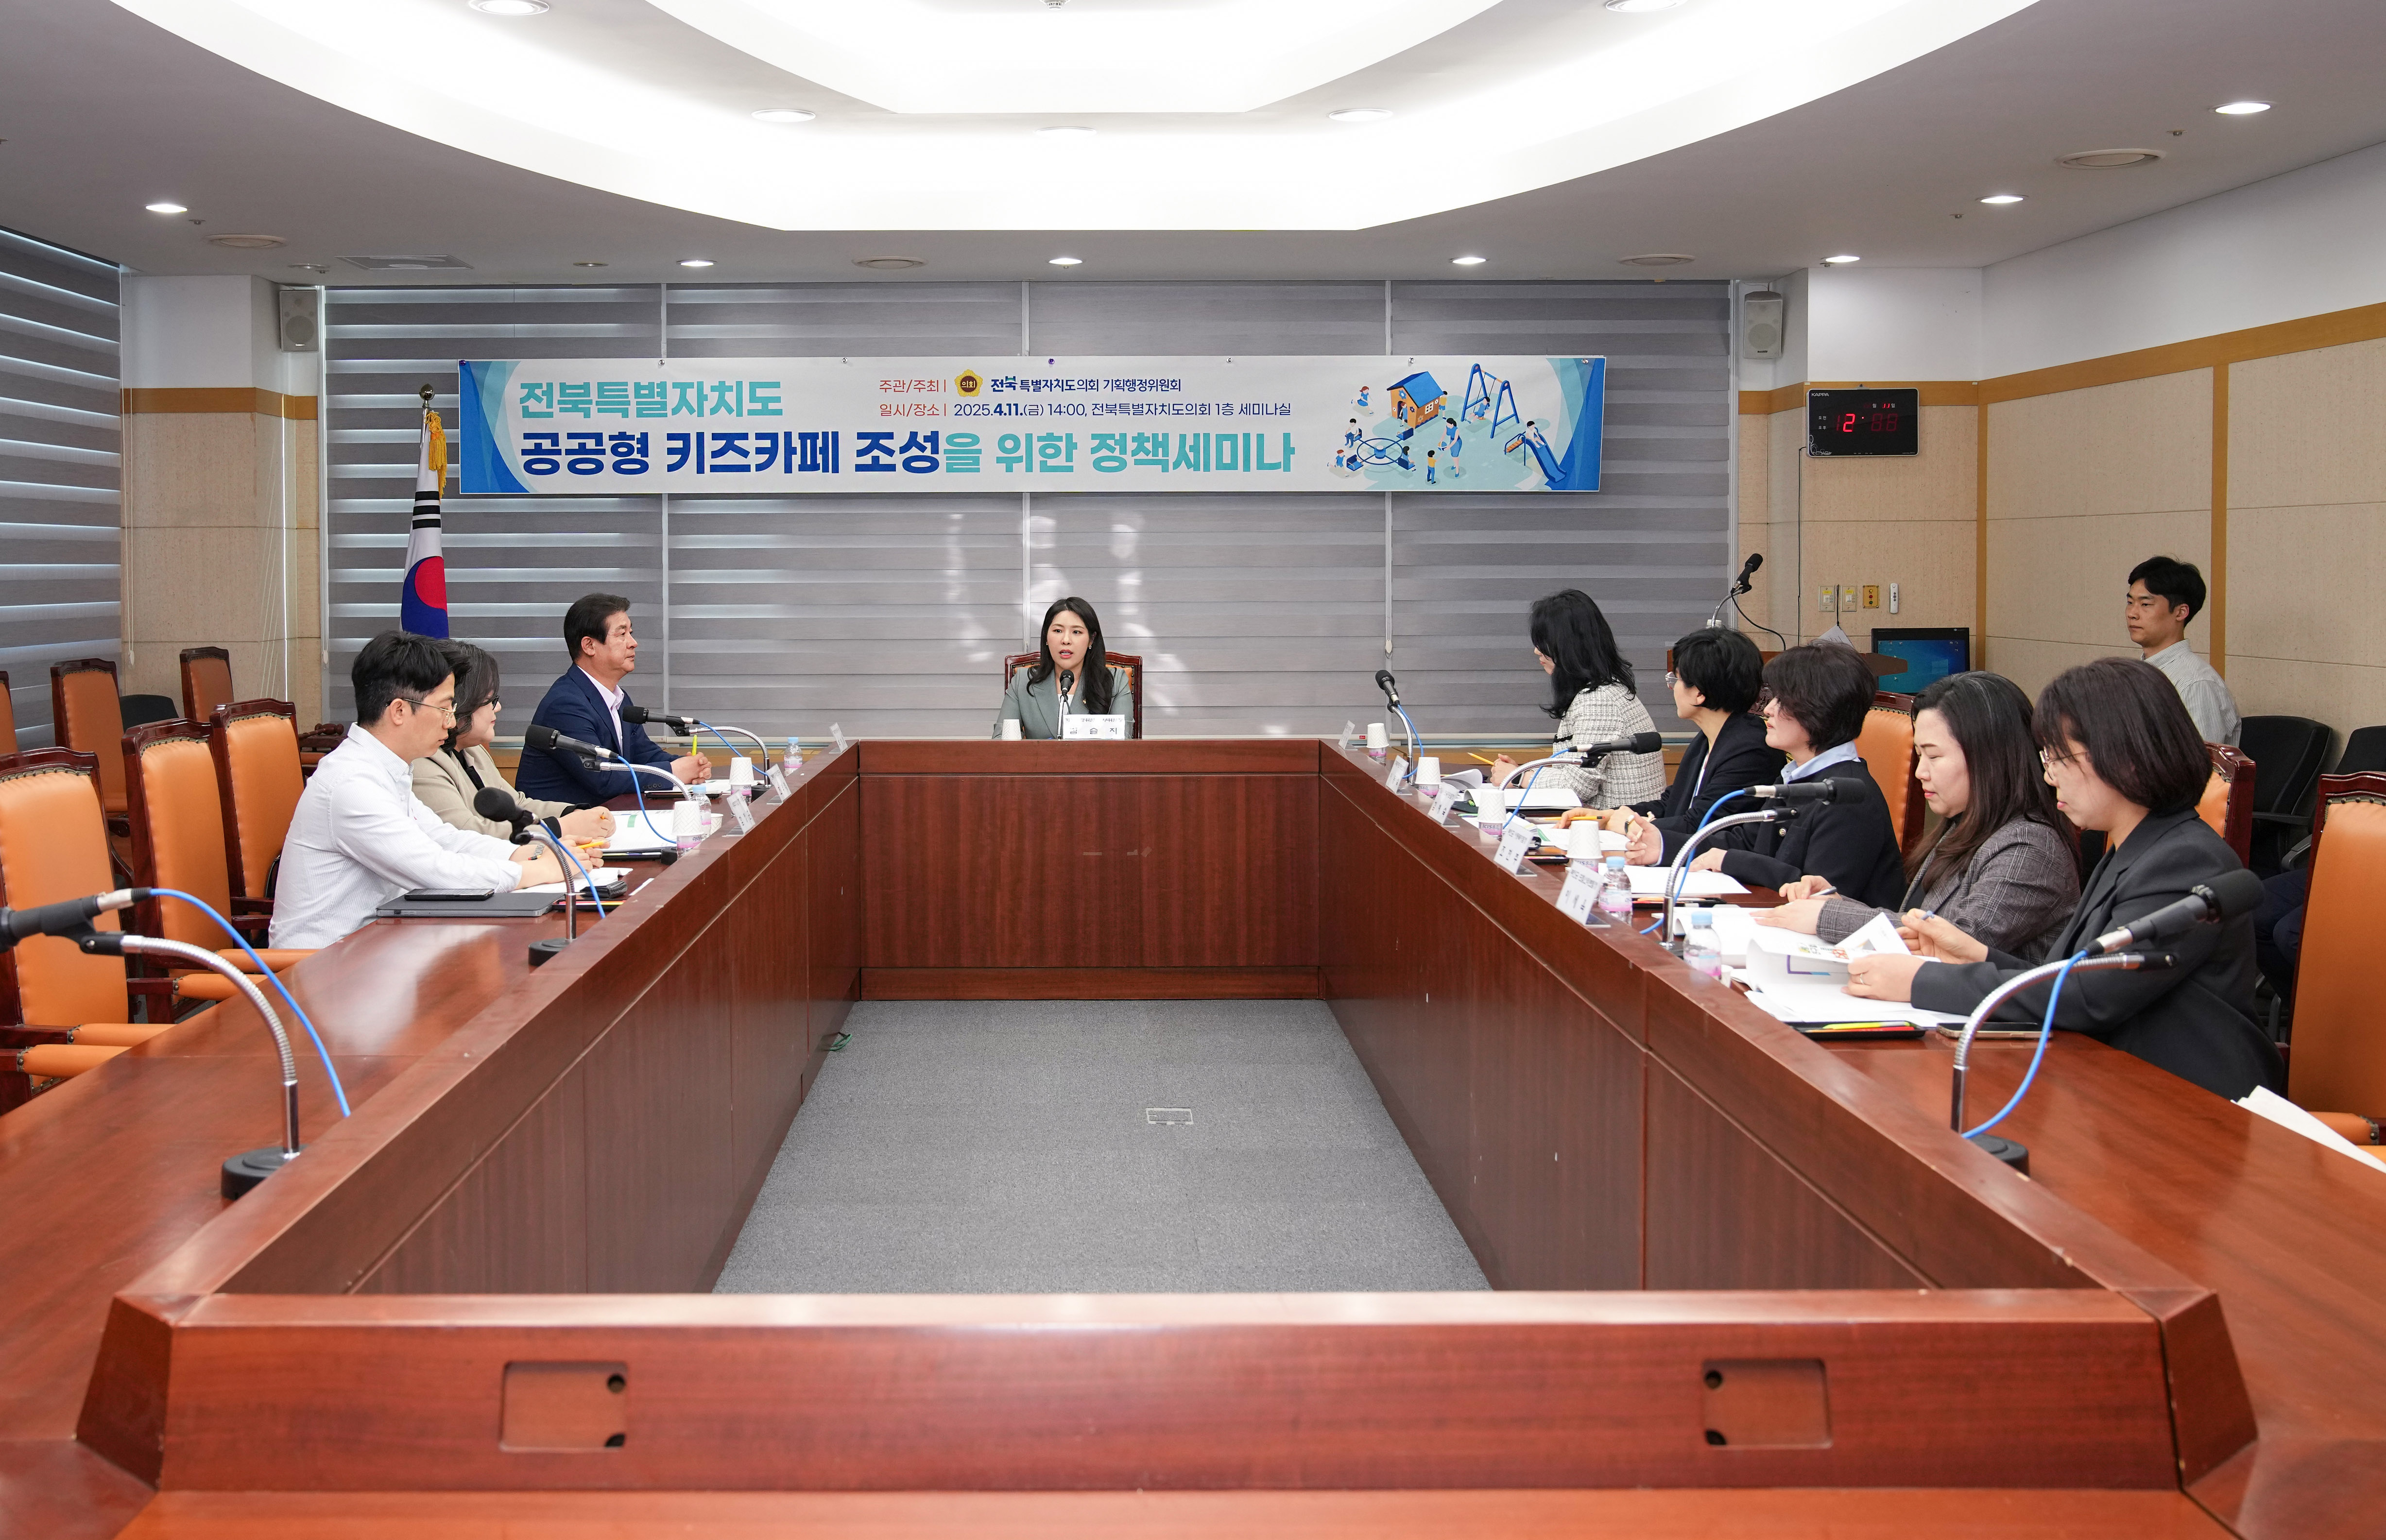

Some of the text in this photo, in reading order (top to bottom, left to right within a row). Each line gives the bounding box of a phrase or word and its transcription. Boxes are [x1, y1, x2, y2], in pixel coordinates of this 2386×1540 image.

[879, 379, 940, 393] 주관/주최
[961, 380, 976, 389] 의회
[1103, 378, 1182, 392] 기획행정위원회
[520, 381, 783, 418] 전북특별자치도
[879, 403, 940, 417] 일시/장소
[954, 403, 1291, 417] 2025.4.11.(금) 14:00, 전북특별자치도의회 1층 세미나실
[521, 430, 1296, 476] 공공형 키즈카페 조성을 위한 정책세미나
